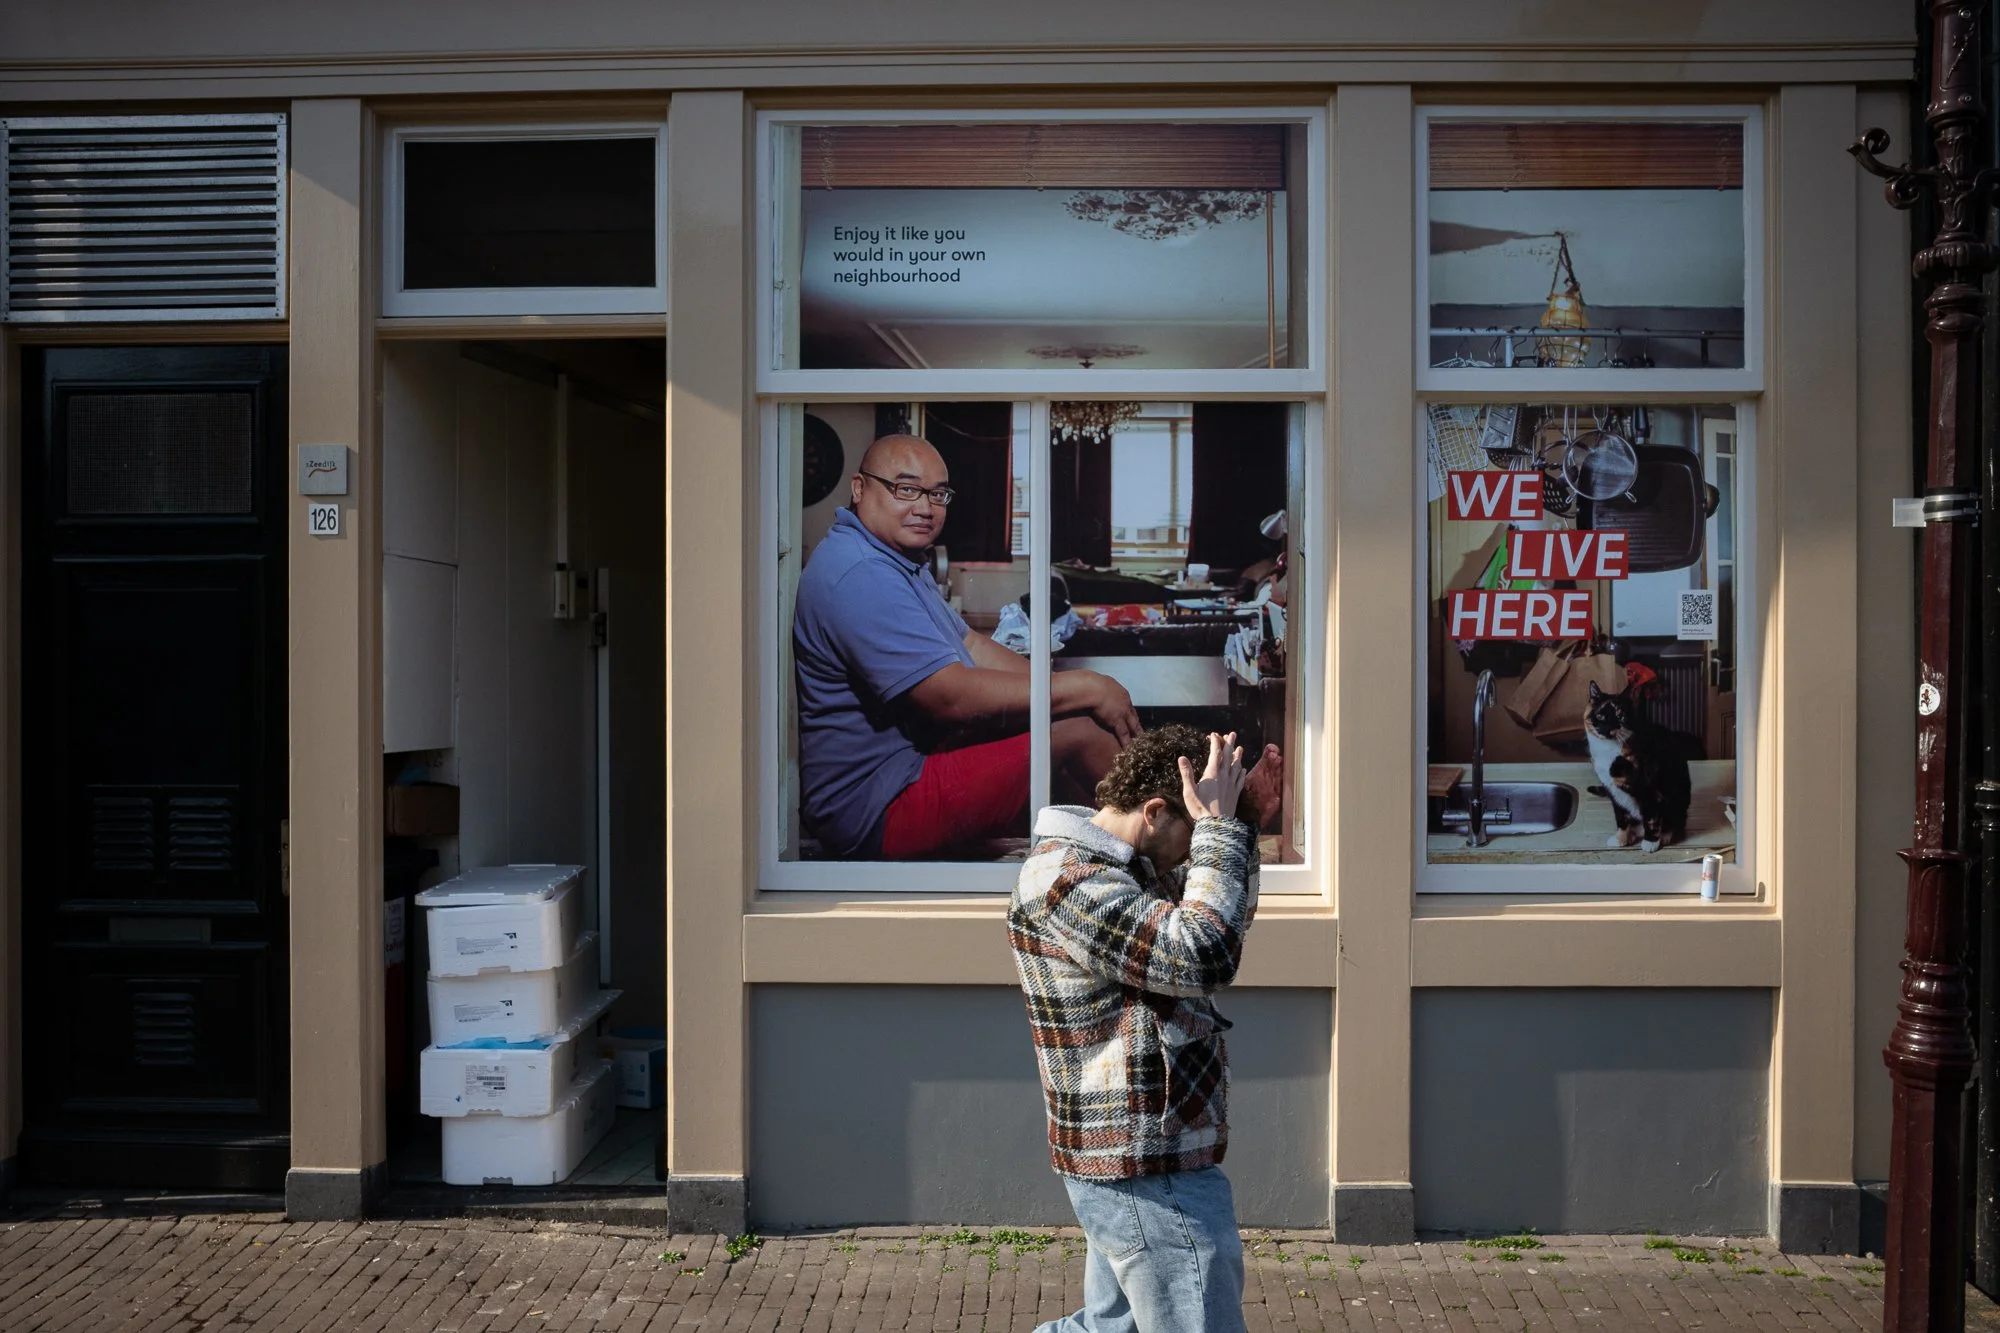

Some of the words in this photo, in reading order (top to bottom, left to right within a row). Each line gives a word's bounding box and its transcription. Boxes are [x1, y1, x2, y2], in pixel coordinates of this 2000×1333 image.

[833, 226, 880, 245] Enjoy
[885, 226, 897, 241] it
[901, 226, 929, 241] like
[934, 229, 966, 244] you
[833, 247, 884, 262] would
[889, 247, 904, 262] in
[909, 249, 947, 265] your
[951, 249, 986, 262] own
[833, 267, 961, 287] neighbourhood
[1450, 474, 1540, 518] WE
[311, 507, 337, 531] 126
[1510, 533, 1625, 577] LIVE
[1451, 592, 1590, 637] HERE
